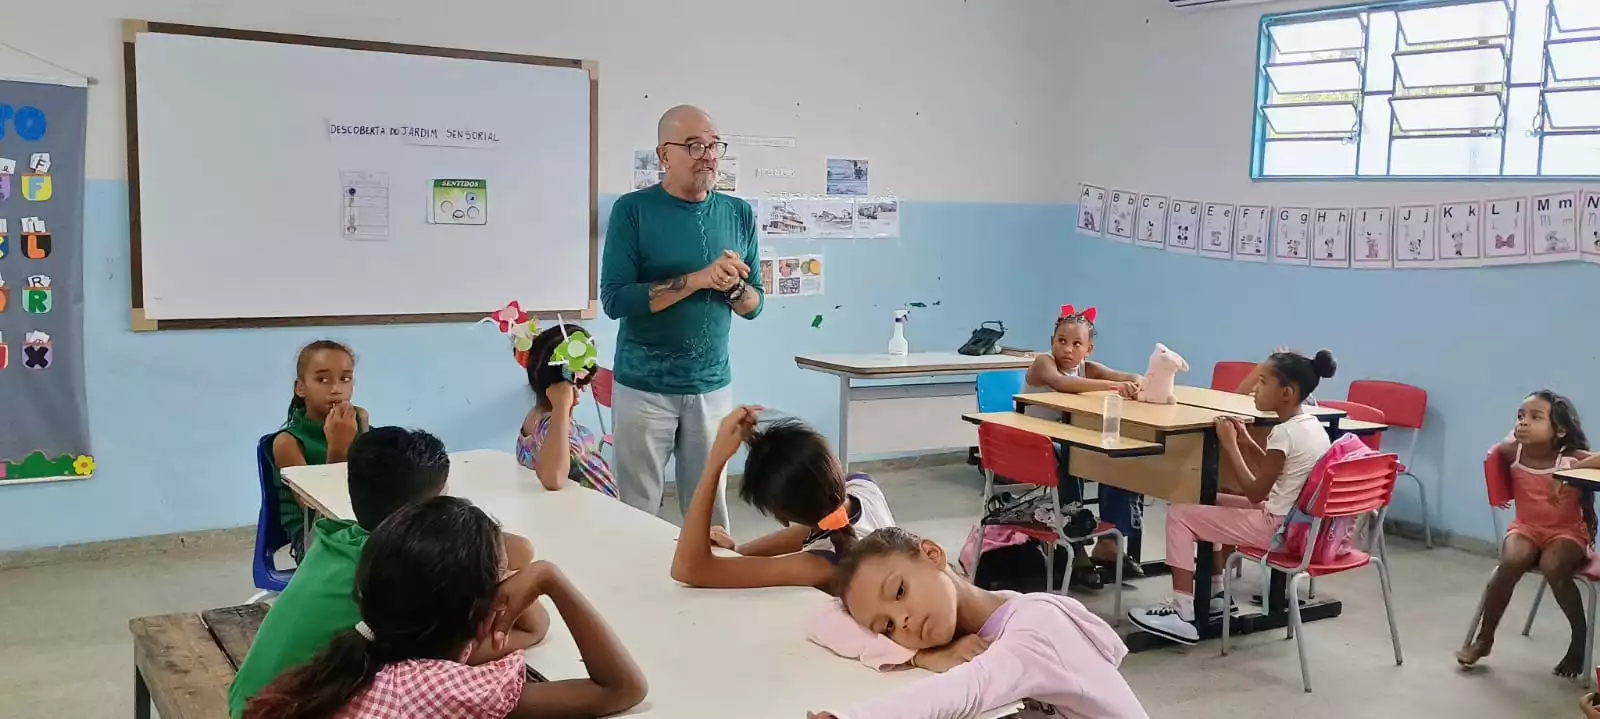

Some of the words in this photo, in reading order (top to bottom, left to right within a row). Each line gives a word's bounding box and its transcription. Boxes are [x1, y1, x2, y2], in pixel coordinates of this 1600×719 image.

[330, 124, 385, 136] DESCOBERTA
[400, 126, 438, 139] JARDIM
[446, 129, 500, 142] SENSORIAL
[29, 176, 45, 200] F
[441, 180, 479, 188] SENTIDOS
[1083, 188, 1090, 198] A
[1097, 193, 1103, 201] a
[1113, 193, 1121, 203] B
[1128, 196, 1134, 206] b
[1142, 198, 1150, 208] C
[1538, 198, 1550, 212] M
[1559, 198, 1573, 209] m
[1587, 195, 1600, 209] N
[1173, 203, 1181, 213] D
[1190, 206, 1198, 215] d
[1207, 206, 1215, 217] E
[1223, 209, 1231, 218] e
[1243, 209, 1250, 219] F
[1260, 209, 1265, 220] f
[1403, 209, 1411, 221] J
[1423, 208, 1429, 223] j
[1443, 206, 1453, 218] K
[1467, 205, 1476, 217] k
[1491, 203, 1500, 215] L
[1280, 210, 1289, 221] G
[1300, 213, 1308, 224] g
[1317, 211, 1327, 222] H
[1338, 211, 1346, 222] h
[27, 235, 46, 259] L
[28, 290, 47, 313] R
[24, 345, 49, 368] X
